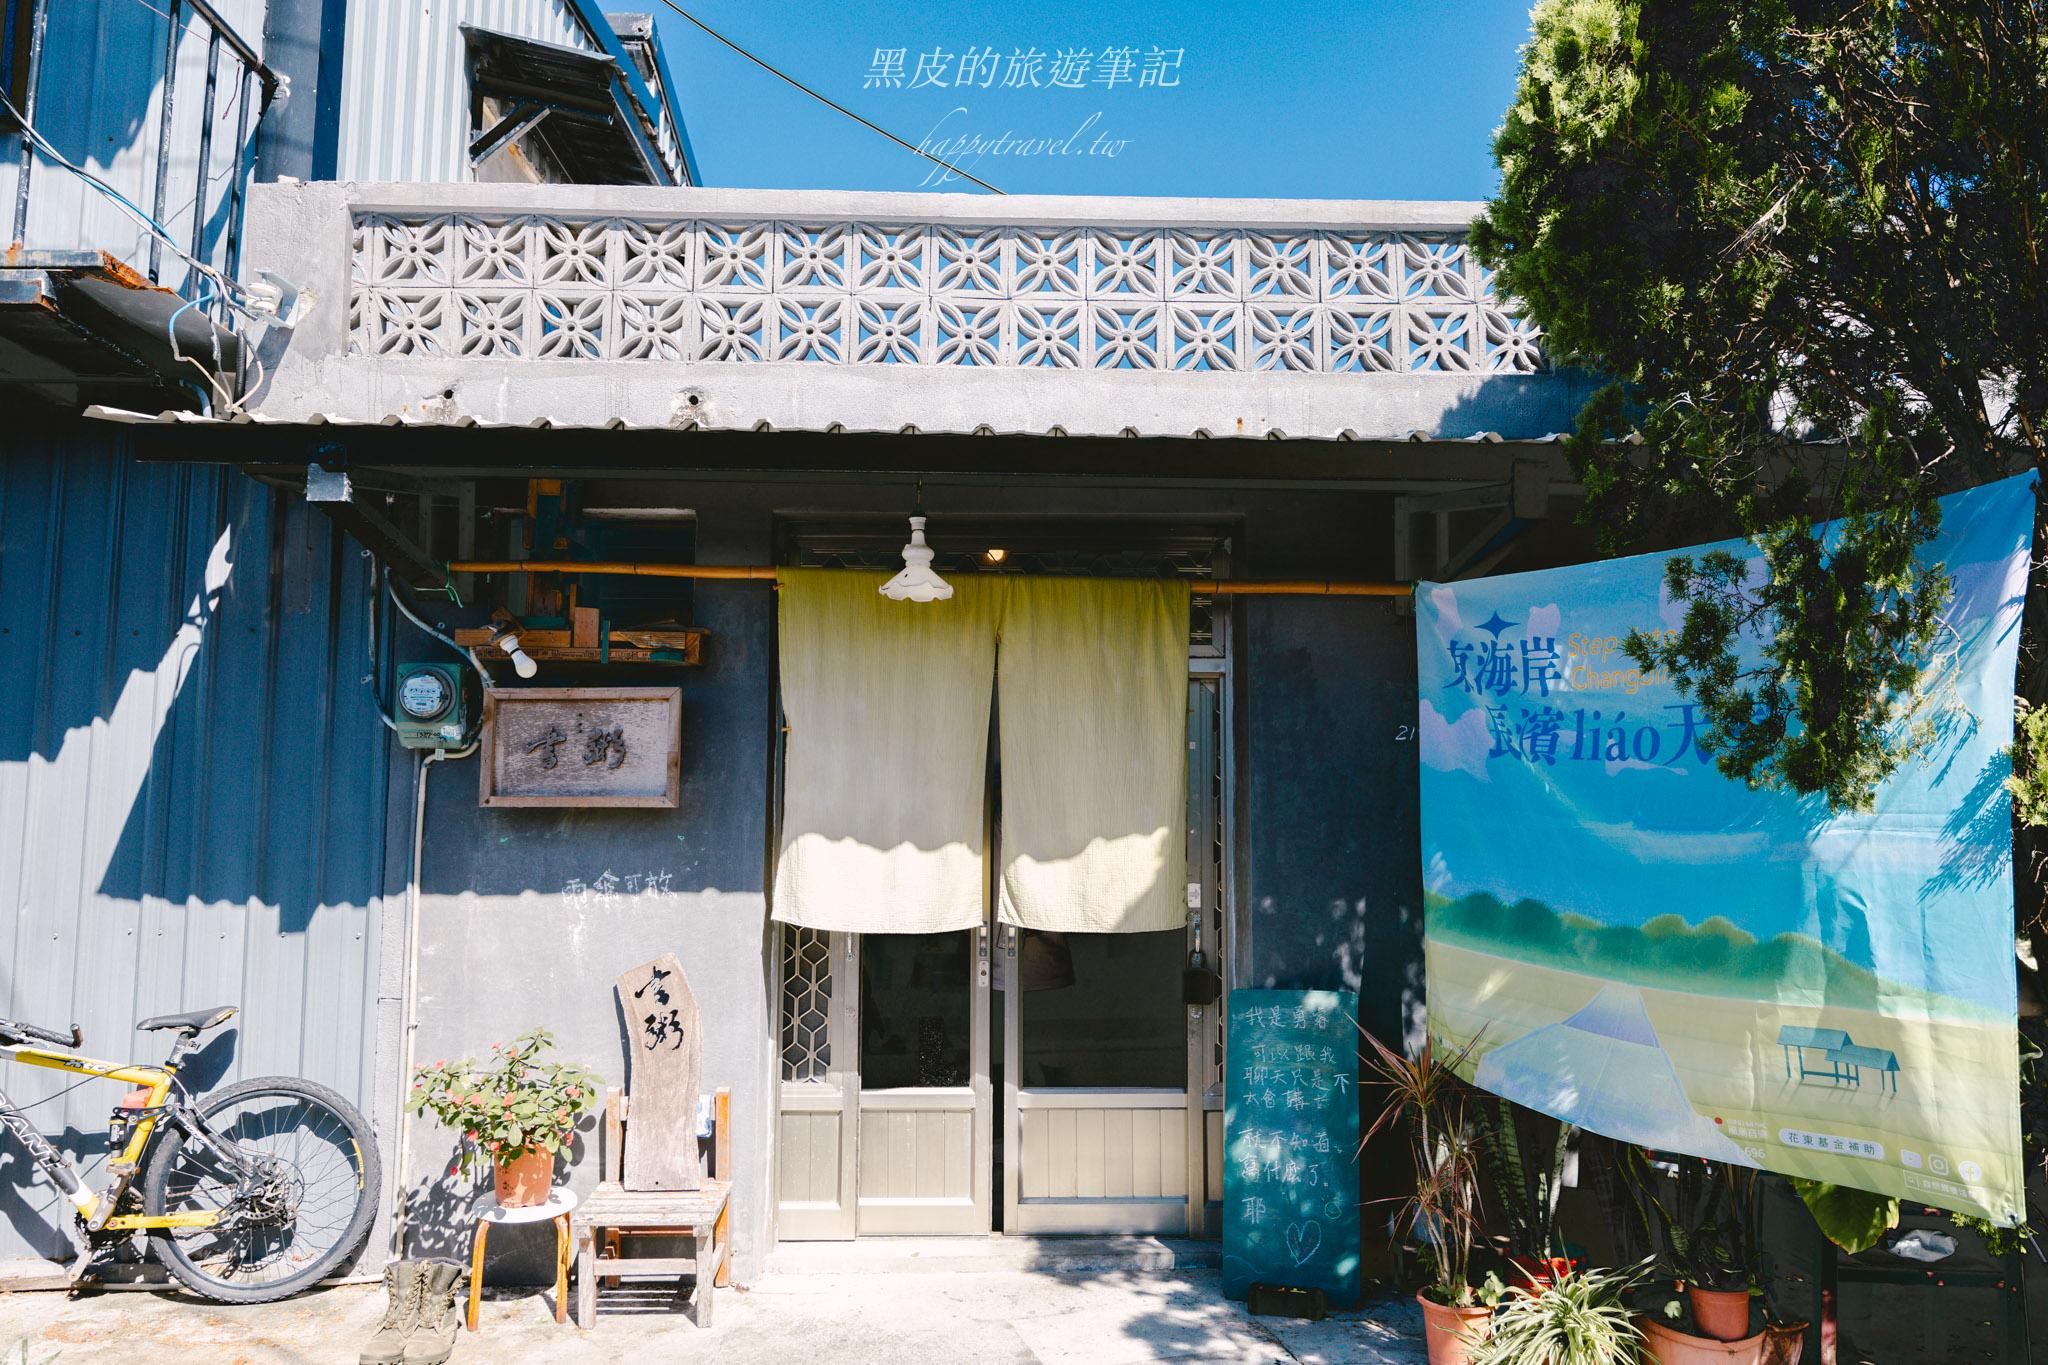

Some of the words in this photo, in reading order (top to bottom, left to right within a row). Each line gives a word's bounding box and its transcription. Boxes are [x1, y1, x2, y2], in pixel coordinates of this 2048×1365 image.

[1567, 633, 1617, 664] Step
[1788, 1132, 1876, 1156] 花東基金補助
